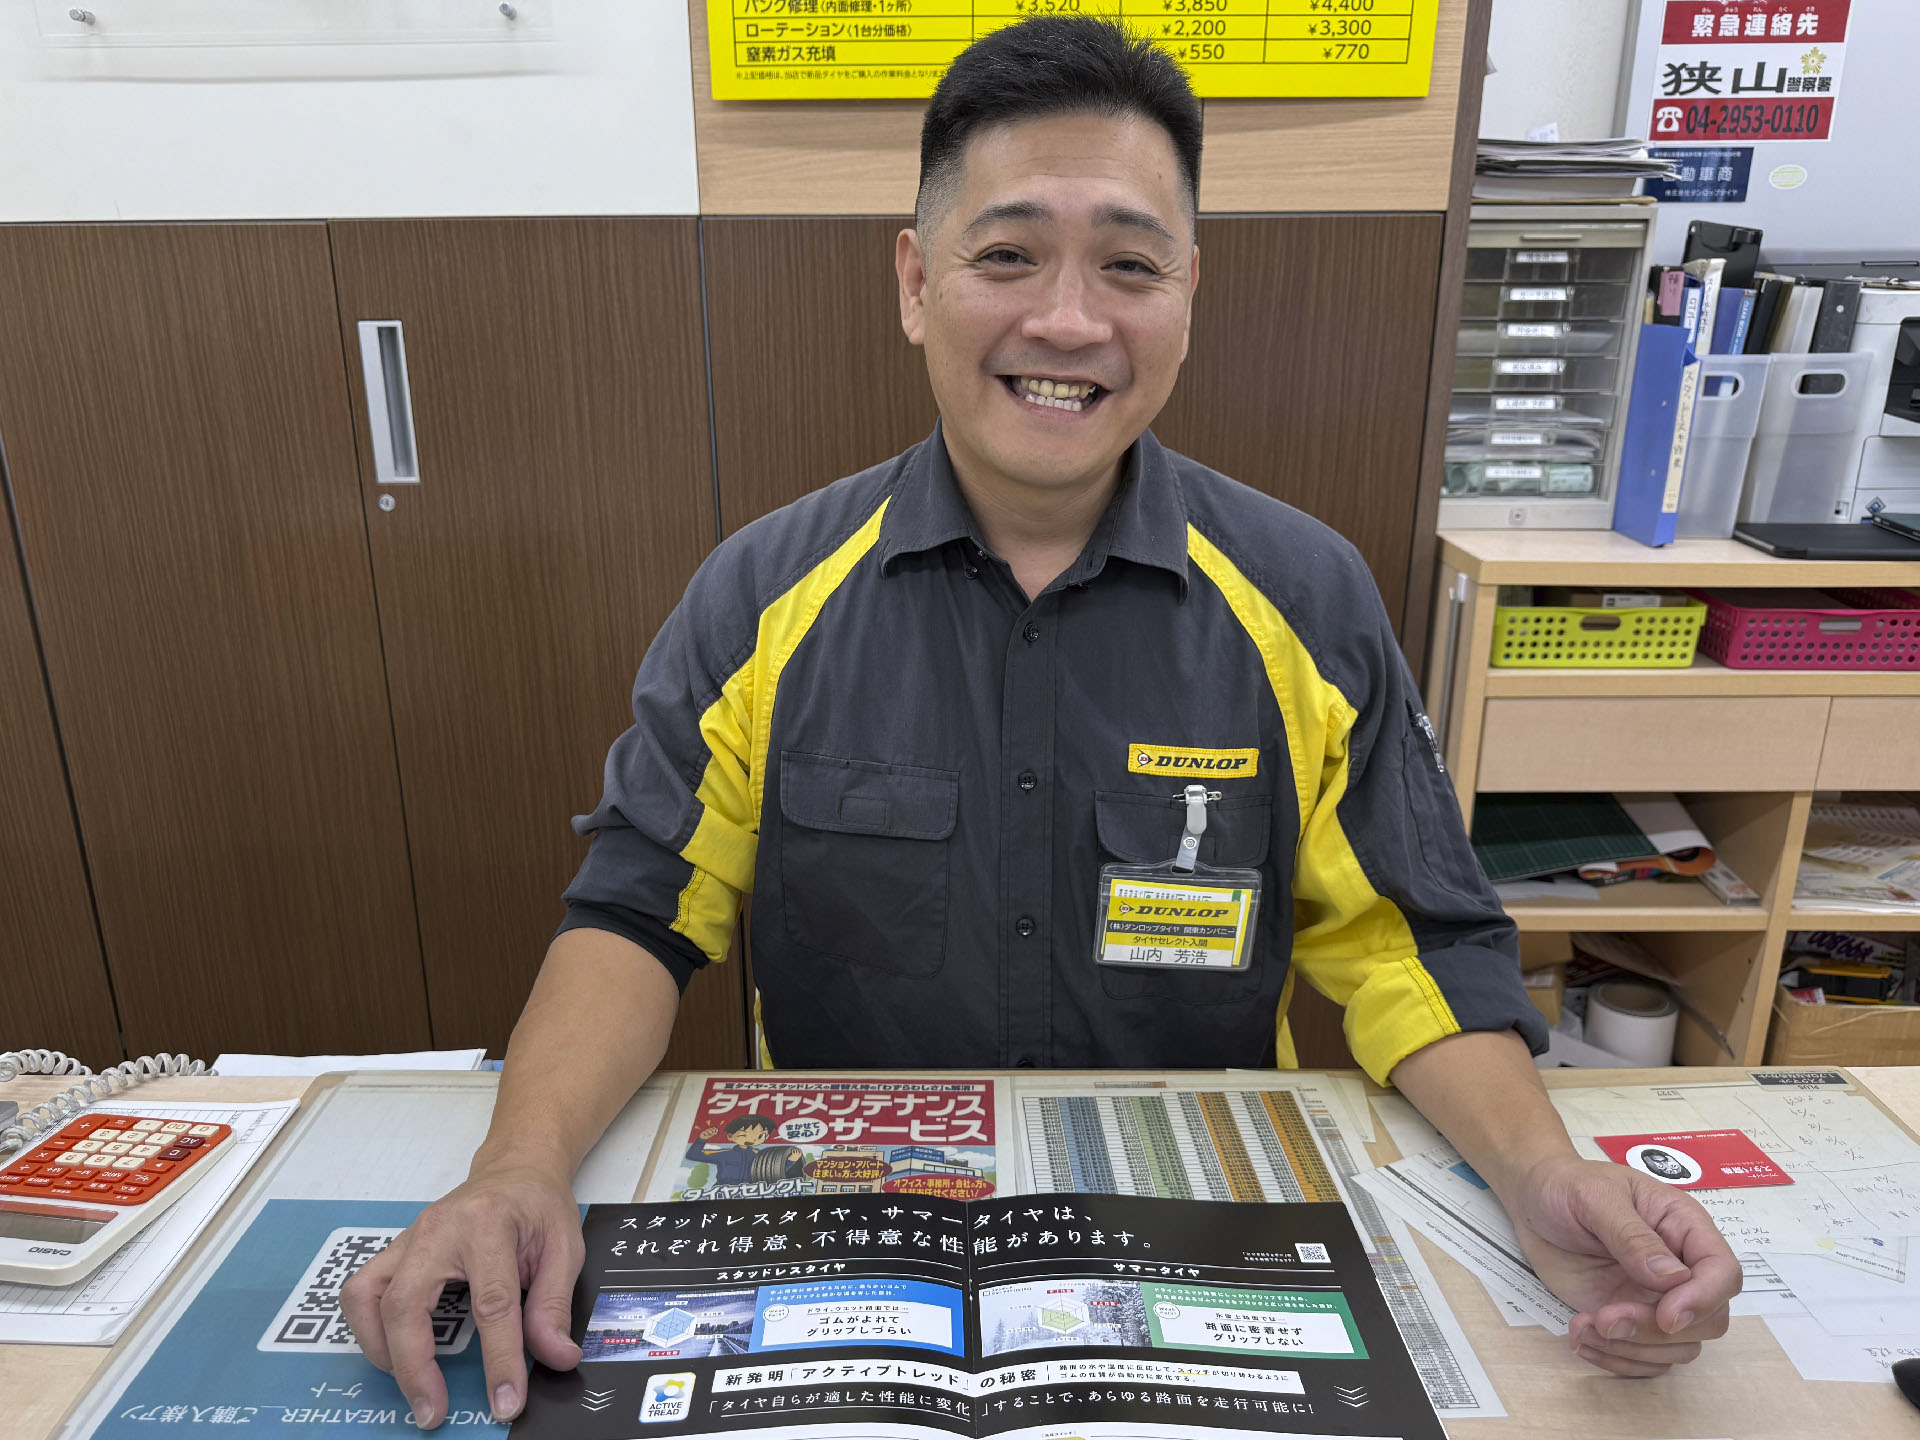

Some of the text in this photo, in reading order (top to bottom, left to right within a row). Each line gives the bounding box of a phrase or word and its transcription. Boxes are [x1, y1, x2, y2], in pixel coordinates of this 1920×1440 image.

[1162, 19, 1226, 37] ¥2,200
[1308, 19, 1372, 37] ¥3,300
[1691, 13, 1819, 37] 緊急連絡先
[746, 46, 836, 62] 窒素ガス充填
[1178, 43, 1225, 60] ¥550
[1323, 43, 1370, 60] ¥770
[1662, 61, 1787, 96] 狭山
[1686, 104, 1819, 134] 04-2953-0110
[1154, 755, 1248, 770] DUNLOP
[1136, 904, 1229, 918] DUNLOP
[1133, 935, 1208, 947] タイヤセレクト入間
[1129, 946, 1208, 964] 山内 芳浩
[706, 1092, 987, 1116] タイヤメンテナンス
[785, 1121, 820, 1132] まかせて
[828, 1117, 988, 1142] サービス
[180, 1136, 200, 1145] AC
[816, 1160, 884, 1170] マンション・アパート
[682, 1178, 814, 1200] タイヤセレクト
[28, 1246, 72, 1256] CASIO
[610, 1230, 1152, 1256] それぞれ得意、不得意な性能があります。
[716, 1262, 847, 1281] スタッドレスタイヤ
[1112, 1261, 1201, 1278] サマータイヤ
[819, 1315, 900, 1325] ゴムがよれて
[1204, 1321, 1303, 1336] 路面に密着せず
[807, 1326, 912, 1337] グリップしづらい
[1213, 1333, 1304, 1346] グリップしない
[724, 1364, 1037, 1391] 新発明「アクティブトレッド」の秘密
[310, 1382, 363, 1400] ケート
[647, 1407, 681, 1418] TREAD
[648, 1401, 683, 1411] ACTIVE
